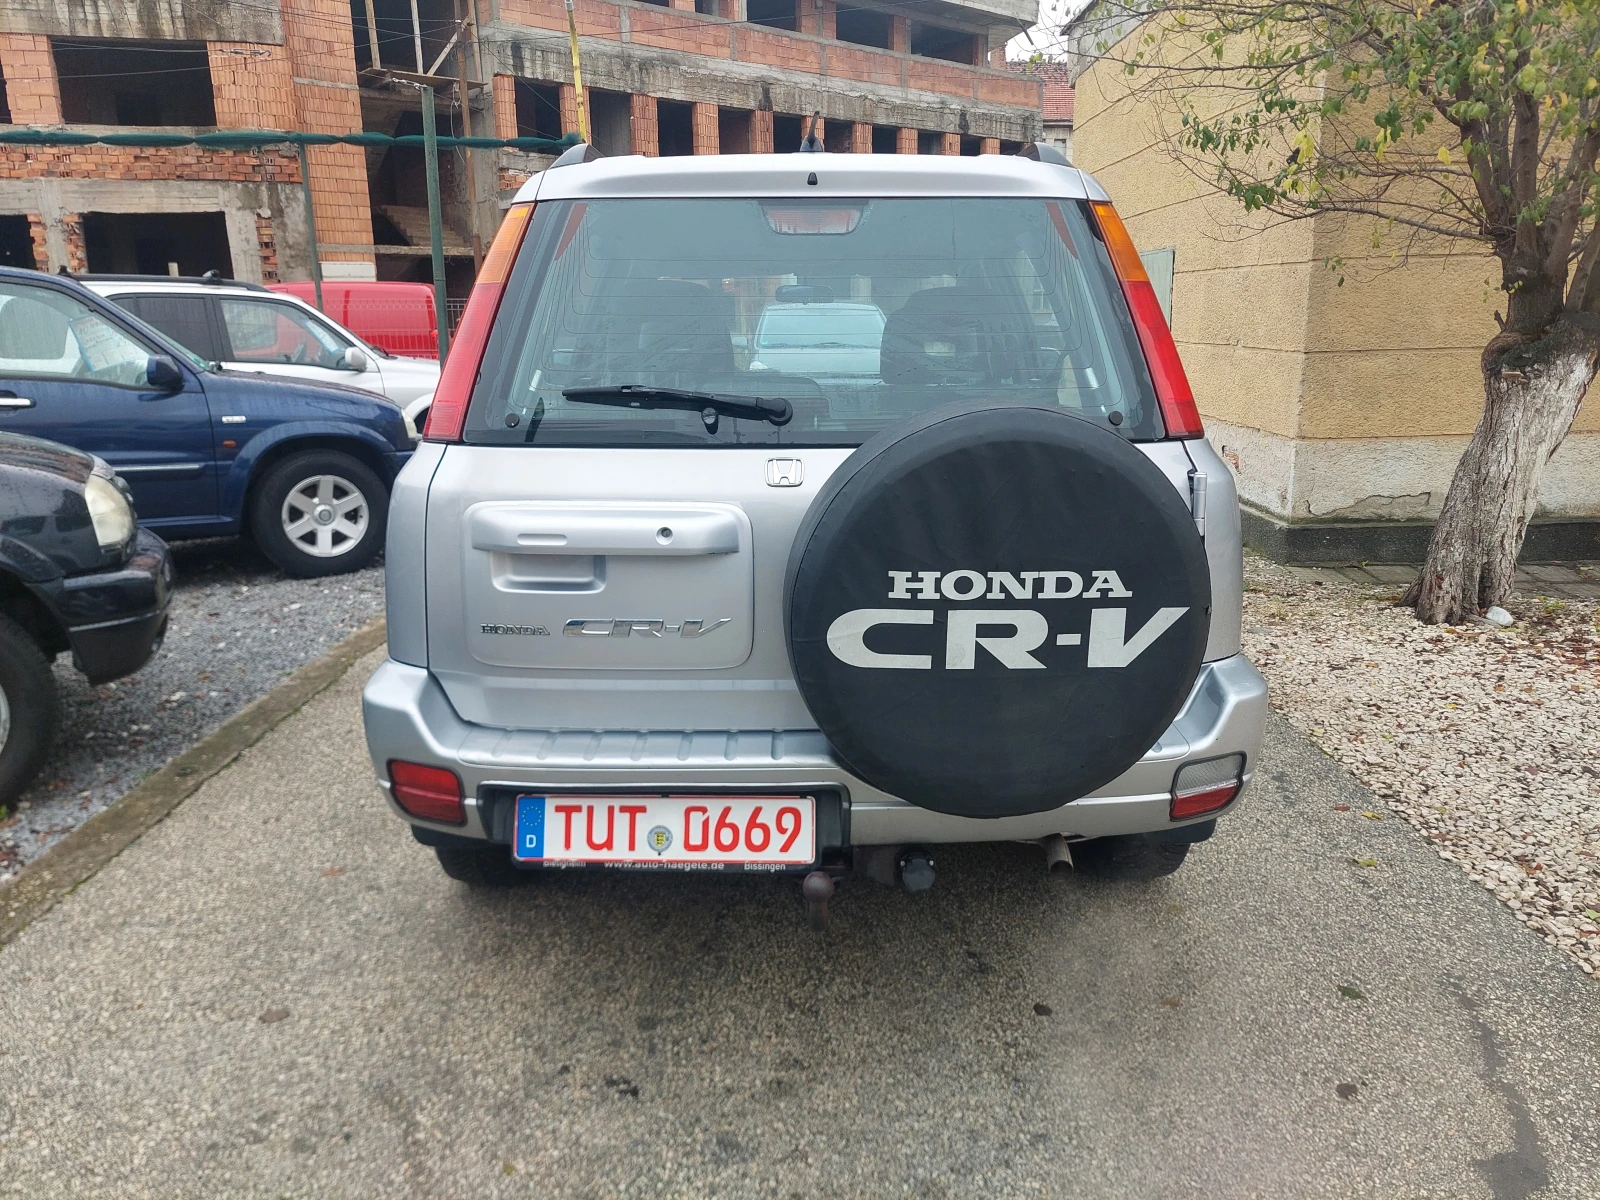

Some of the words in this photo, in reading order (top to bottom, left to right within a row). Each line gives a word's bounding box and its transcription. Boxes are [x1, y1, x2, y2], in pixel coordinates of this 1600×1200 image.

[888, 570, 1133, 600] HONDA
[480, 622, 551, 637] HONDA
[562, 617, 732, 638] CR-V
[826, 607, 1190, 670] CR-V
[525, 834, 537, 848] D
[554, 804, 648, 852] TUT
[683, 805, 802, 853] 0669
[743, 861, 786, 873] Bissingen
